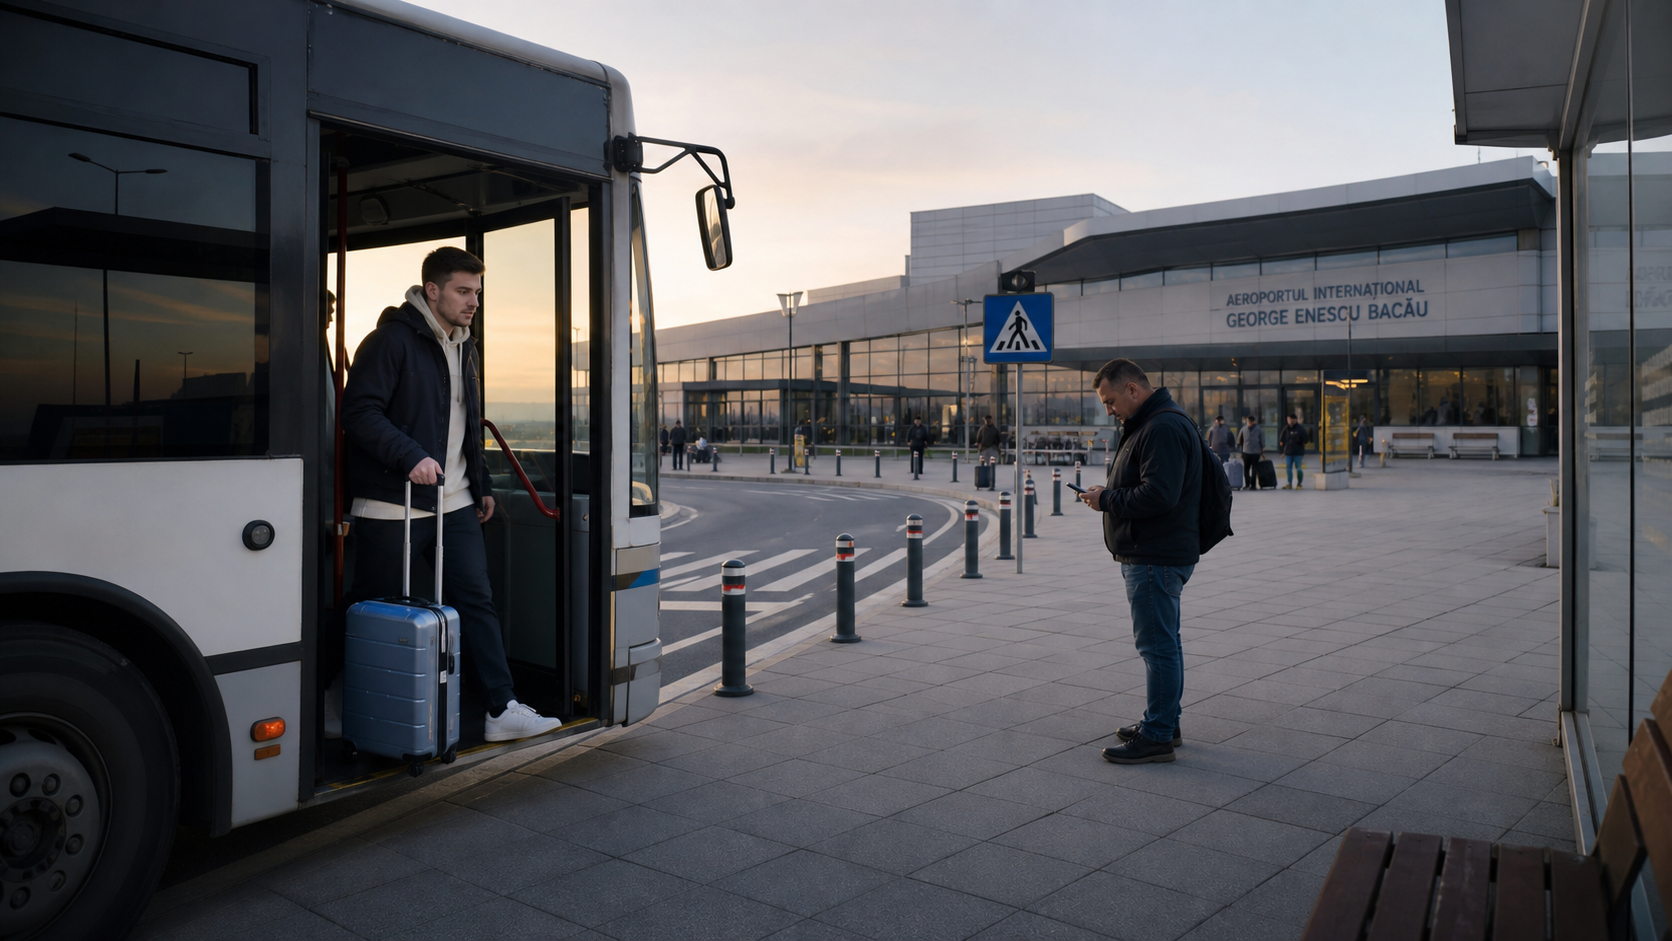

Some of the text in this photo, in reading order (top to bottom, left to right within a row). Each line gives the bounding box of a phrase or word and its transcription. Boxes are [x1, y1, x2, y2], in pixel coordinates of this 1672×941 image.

[1226, 288, 1309, 306] AEROPORTUL
[1226, 297, 1428, 328] GEORGE ENESCU BACĂU
